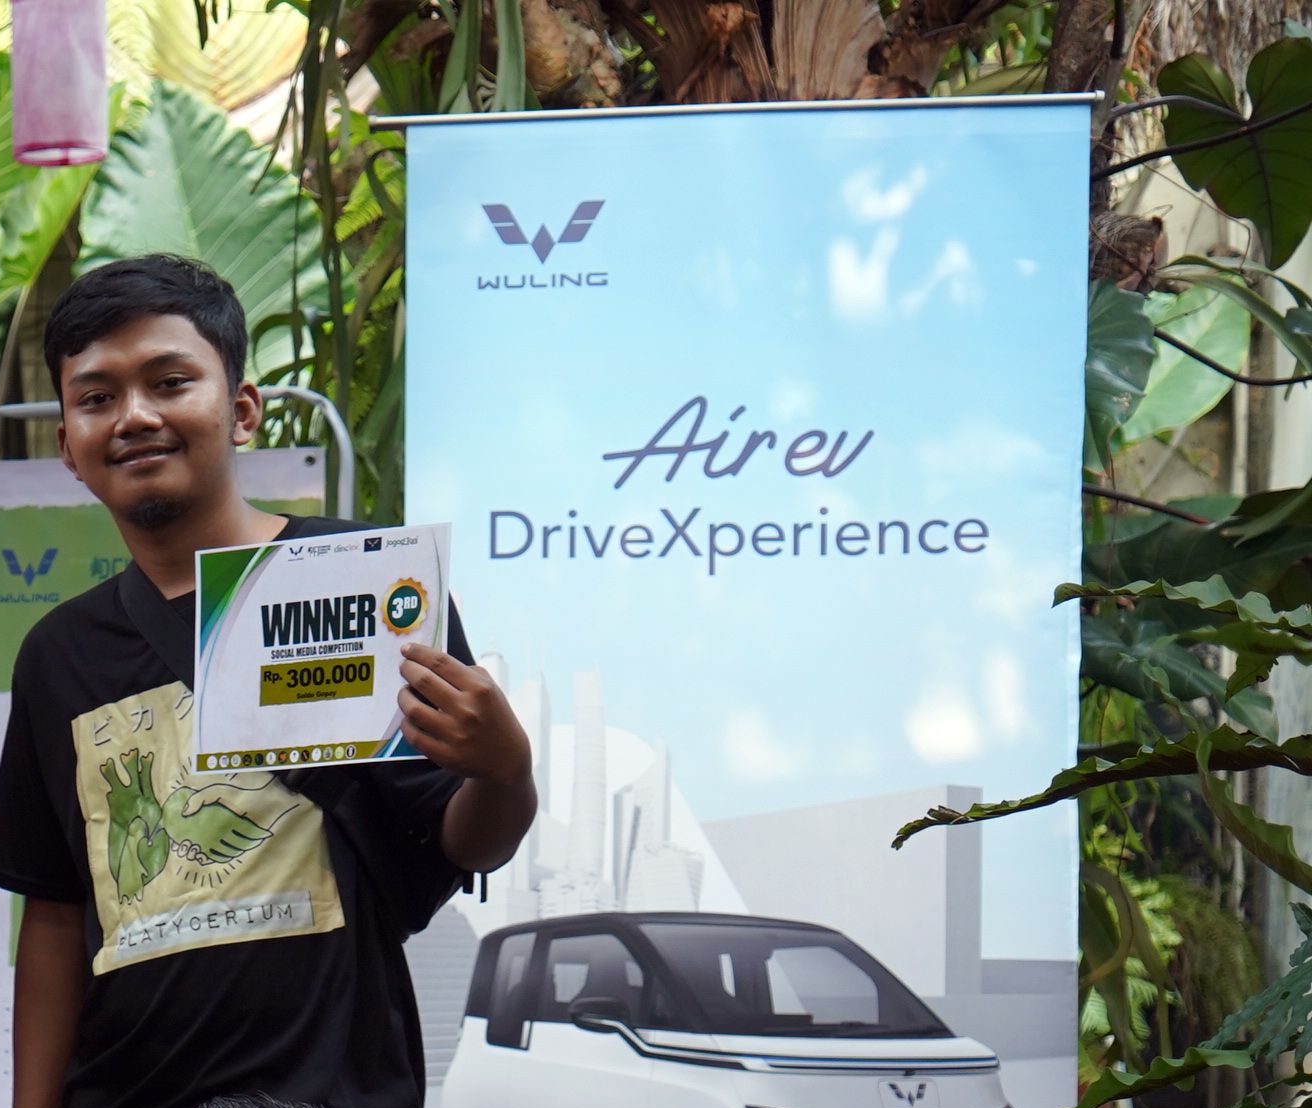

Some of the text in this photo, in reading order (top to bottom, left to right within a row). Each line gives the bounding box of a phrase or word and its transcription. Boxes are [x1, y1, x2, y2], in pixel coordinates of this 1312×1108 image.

[478, 271, 608, 290] WULING
[490, 507, 989, 576] DriveXperience
[392, 596, 417, 620] 3RD
[261, 594, 376, 648] WINNER
[271, 642, 363, 659] SOCIAL MEDIA COMPETITION
[264, 662, 370, 688] Rp. 300.000
